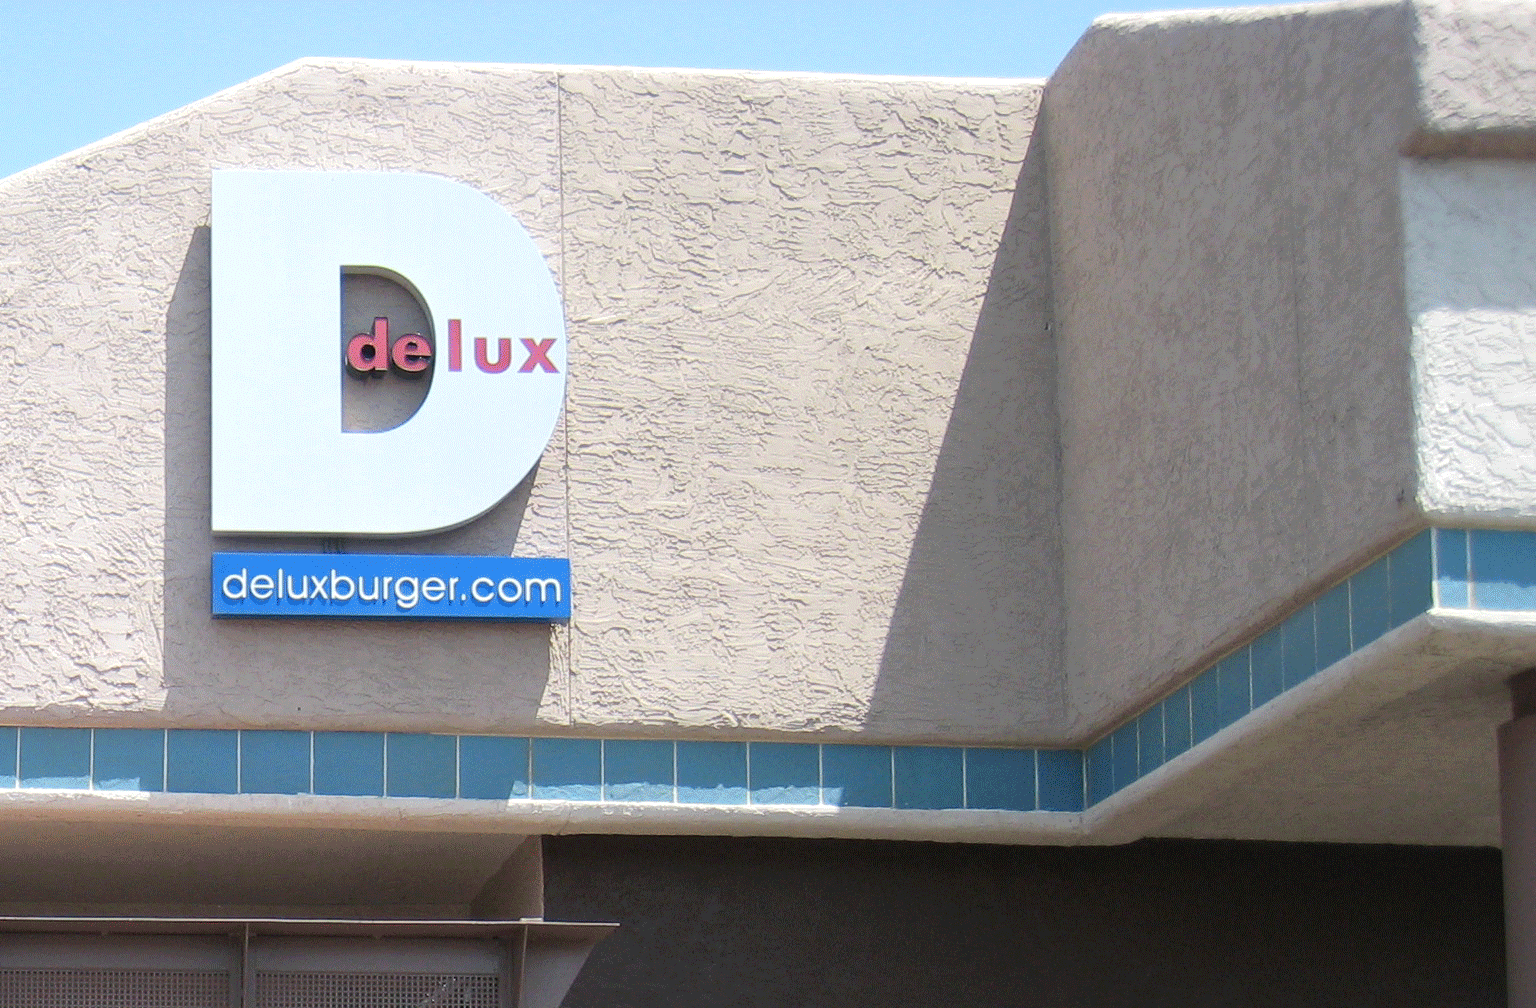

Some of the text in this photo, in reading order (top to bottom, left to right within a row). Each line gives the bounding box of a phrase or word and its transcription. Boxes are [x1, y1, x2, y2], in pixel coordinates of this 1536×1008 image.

[211, 170, 566, 538] D
[346, 316, 561, 375] delux
[221, 567, 562, 609] deluxburger.com
